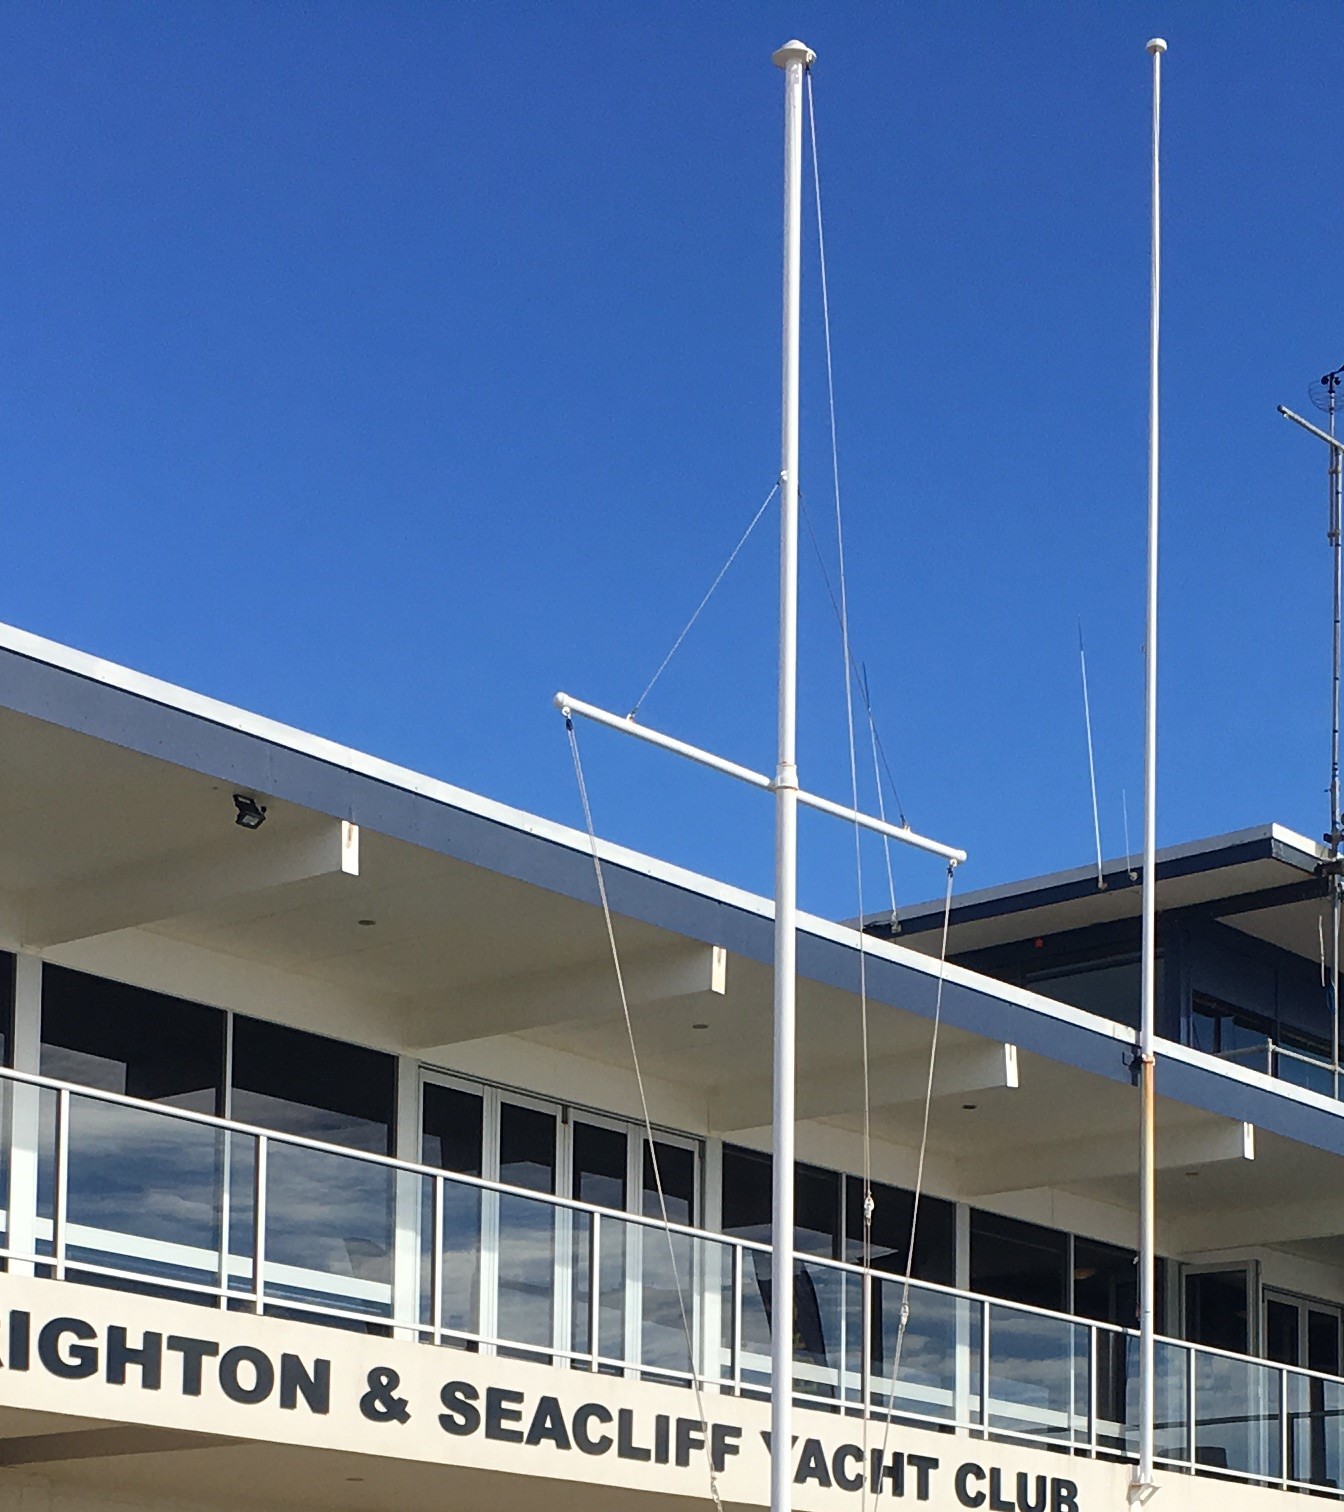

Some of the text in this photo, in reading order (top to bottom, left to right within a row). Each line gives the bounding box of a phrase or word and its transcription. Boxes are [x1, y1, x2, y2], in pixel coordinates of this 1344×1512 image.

[359, 1366, 411, 1425] &
[438, 1380, 743, 1473] SEACLIFF
[761, 1430, 940, 1501] YACHT
